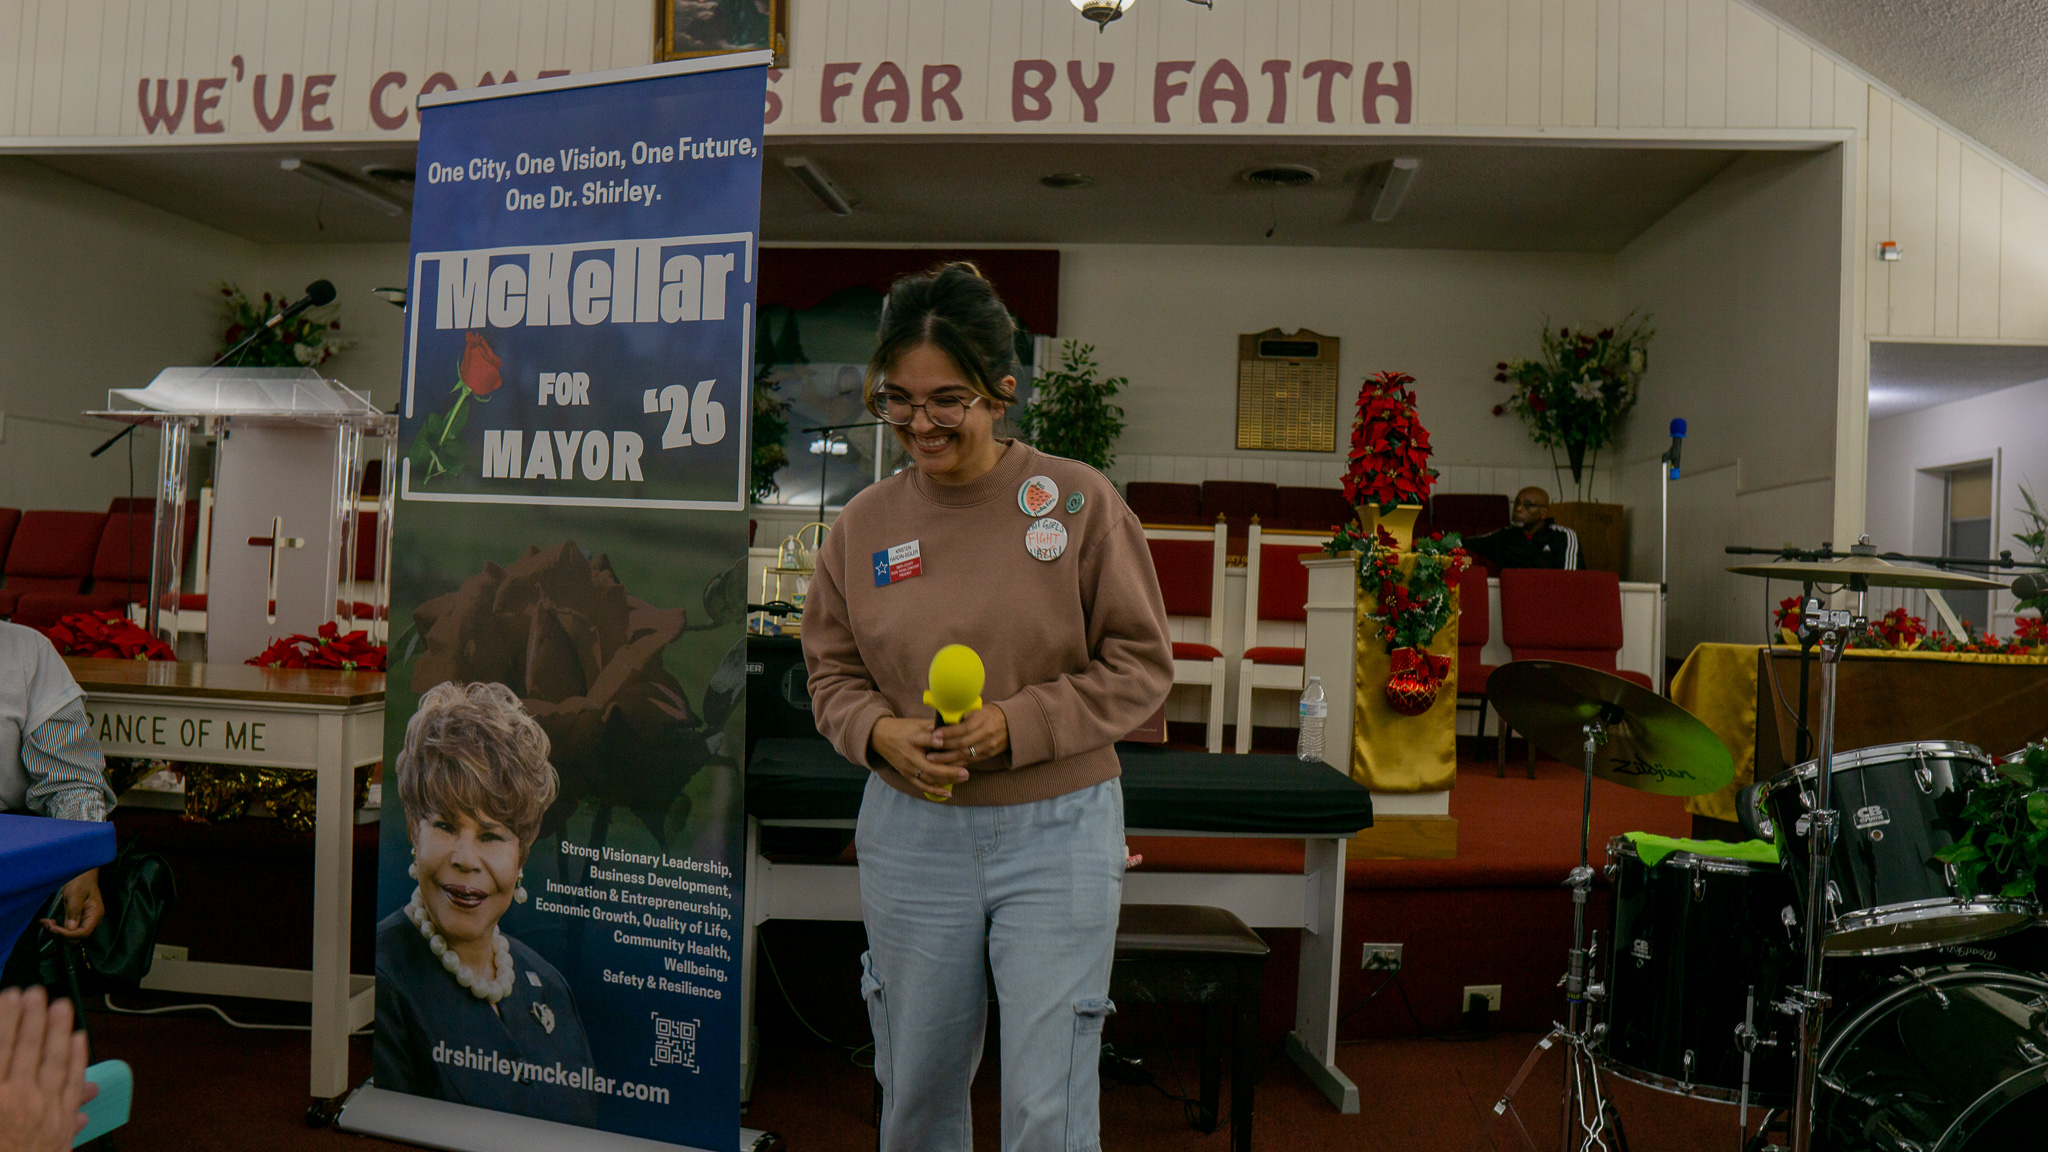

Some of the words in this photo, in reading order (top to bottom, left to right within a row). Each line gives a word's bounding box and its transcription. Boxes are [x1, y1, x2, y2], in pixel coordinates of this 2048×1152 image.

[138, 54, 336, 134] WE'VE
[820, 61, 964, 123] FAR
[1011, 58, 1115, 122] BY
[1152, 58, 1413, 124] FAITH
[428, 161, 464, 185] One
[468, 156, 511, 183] City,
[515, 152, 556, 176] One
[559, 146, 627, 173] Vision,
[631, 140, 674, 165] One
[678, 135, 758, 161] Future,
[505, 188, 546, 212] One
[549, 184, 578, 209] Dr.
[581, 178, 662, 208] Shirley.
[436, 246, 735, 330] McKellar
[538, 372, 590, 406] FOR
[482, 429, 644, 482] MAYOR
[1027, 531, 1062, 546] FIGHT
[1043, 519, 1064, 533] GIRLS
[180, 718, 212, 748] OF
[225, 720, 266, 752] ME
[1609, 752, 1696, 782] Zildjian
[1857, 805, 1883, 818] CB
[561, 840, 600, 861] Strong
[602, 846, 660, 868] Visionary
[662, 853, 733, 878] Leadership,
[546, 878, 607, 900] Innovation
[609, 888, 619, 902] &
[621, 890, 732, 920] Entrepreneurship,
[590, 865, 645, 885] Business
[648, 872, 732, 899] Development,
[535, 897, 591, 918] Economic
[592, 906, 641, 927] Growth,
[643, 913, 687, 934] Quality
[689, 921, 703, 934] of
[704, 922, 732, 941] Life,
[614, 930, 685, 954] Community
[687, 940, 731, 961] Health,
[603, 969, 645, 989] Safety
[647, 975, 657, 989] &
[659, 977, 722, 1000] Resilience
[664, 956, 728, 982] Wellbeing,
[432, 1040, 671, 1105] drshirleymckellar.com
